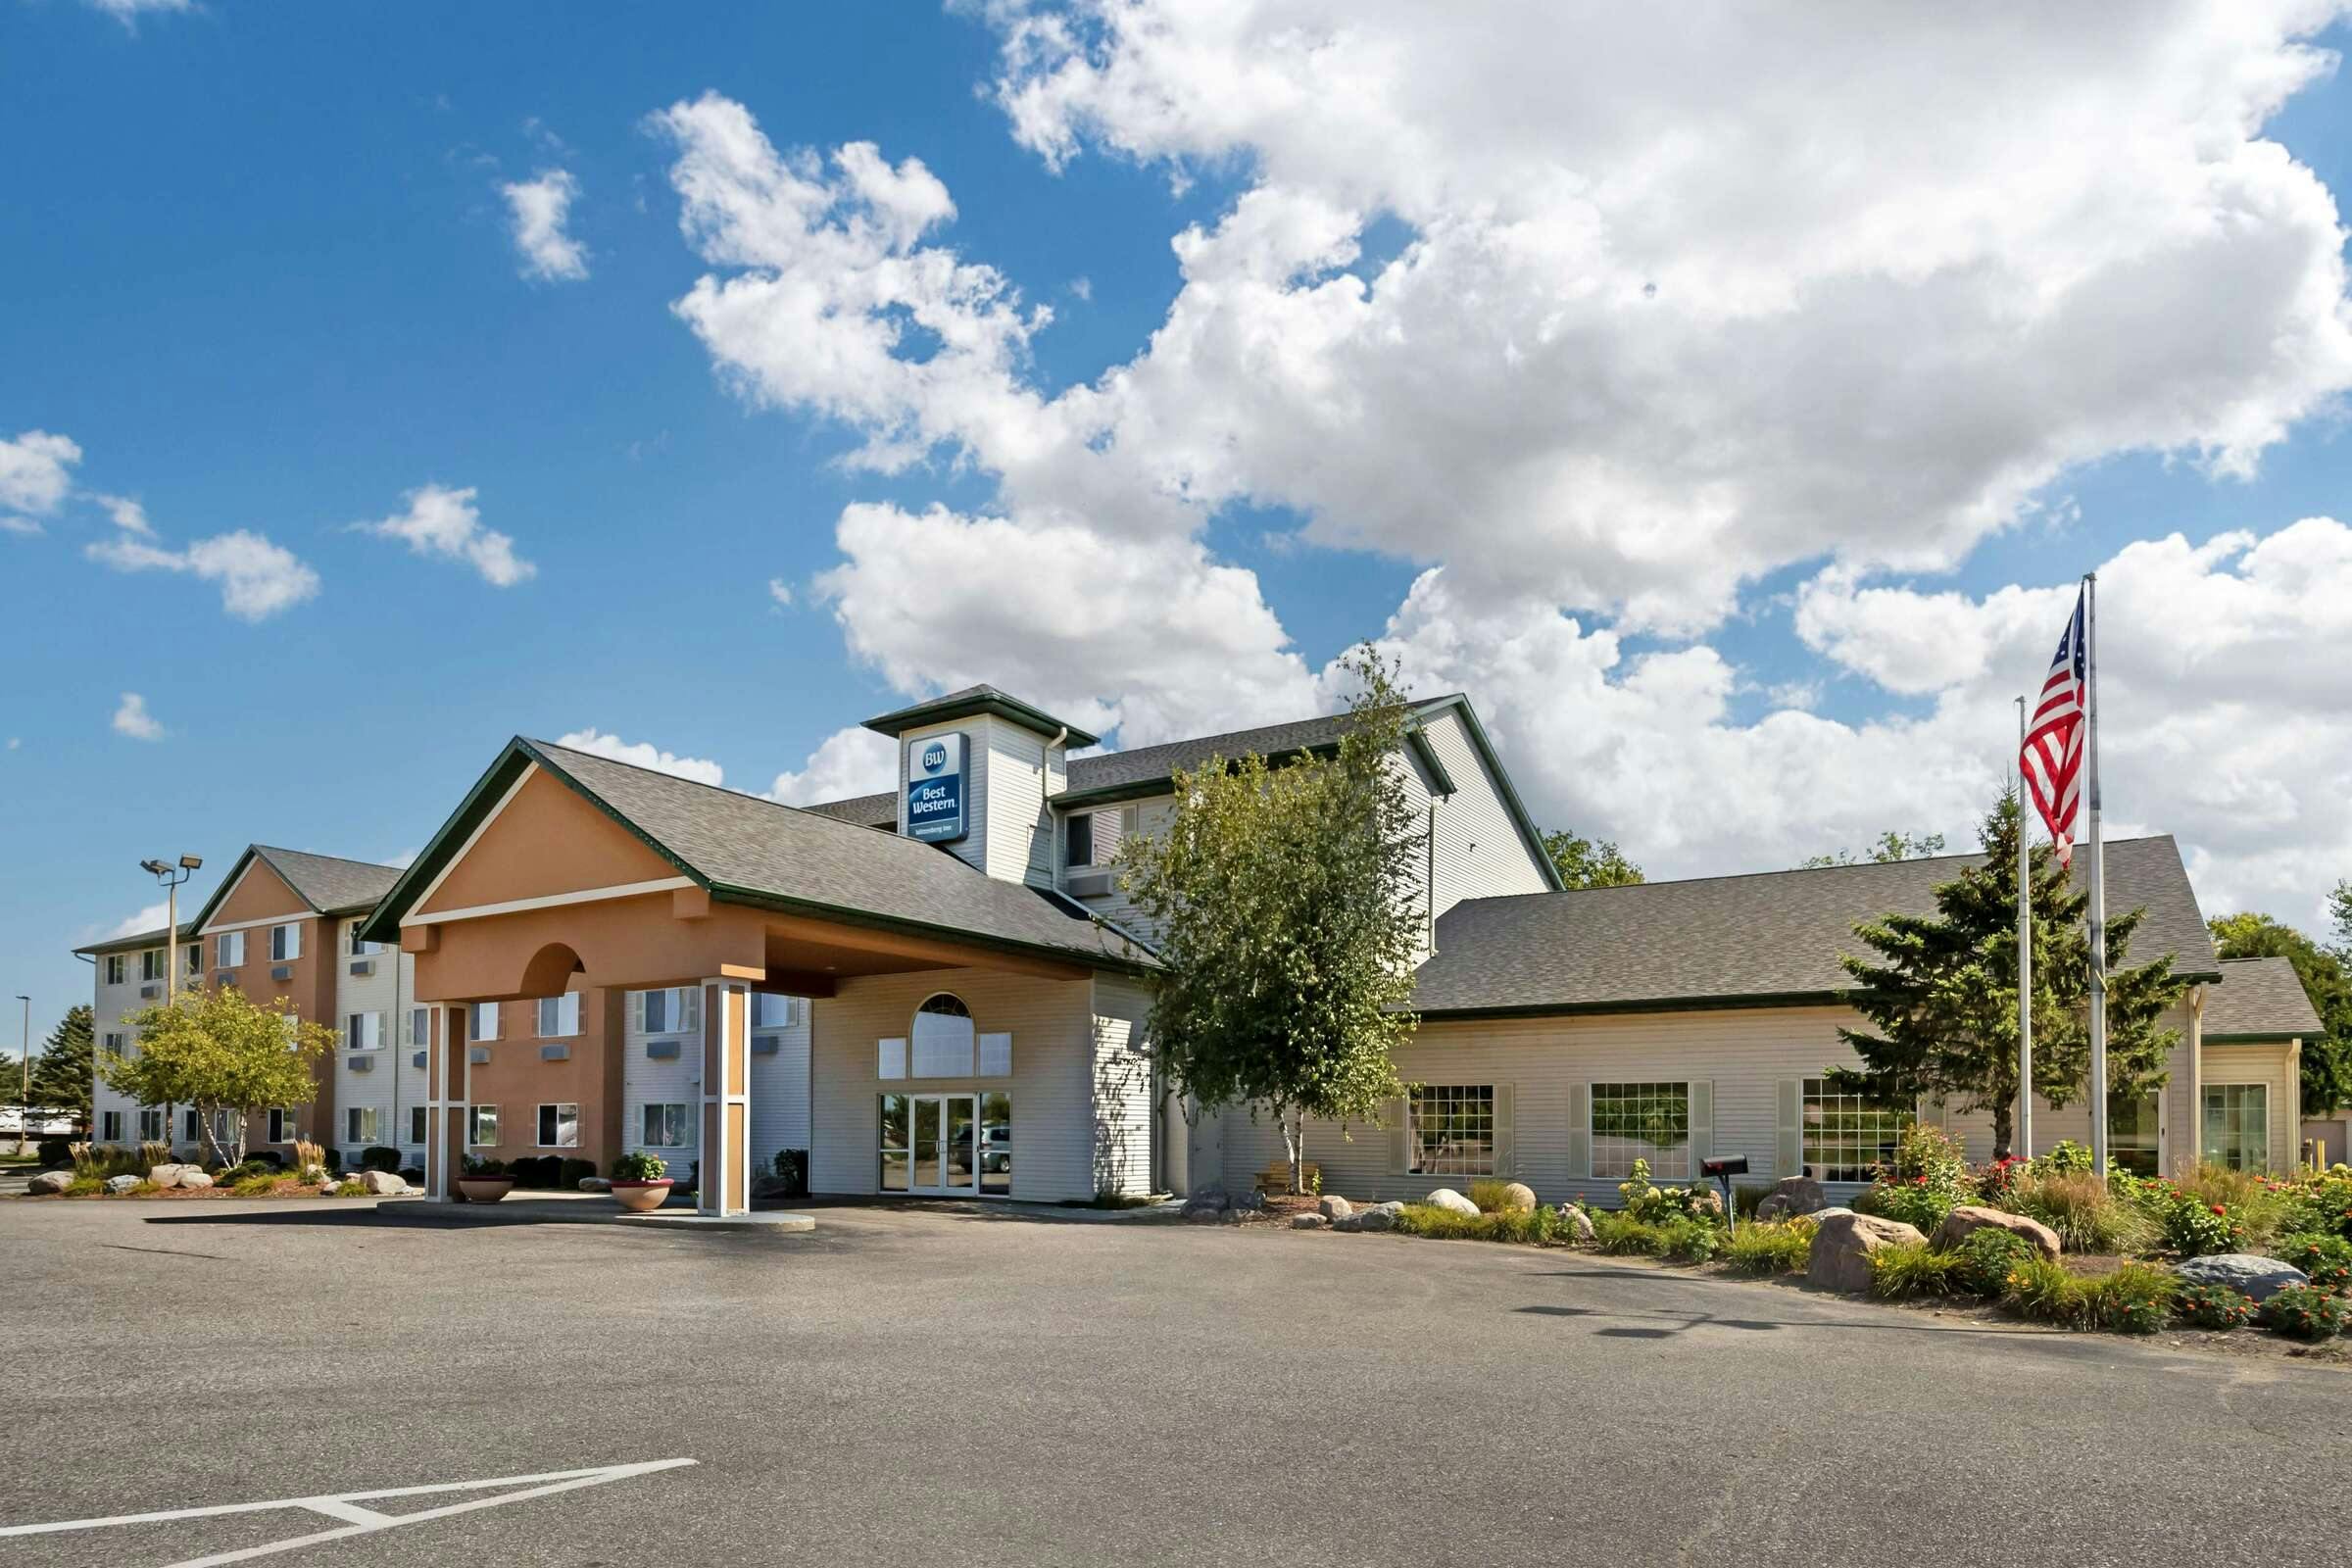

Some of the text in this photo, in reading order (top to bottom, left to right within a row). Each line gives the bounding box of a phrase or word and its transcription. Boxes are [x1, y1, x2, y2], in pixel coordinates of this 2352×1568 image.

[925, 751, 945, 766] BW
[923, 786, 946, 800] Best
[913, 798, 955, 814] Western
